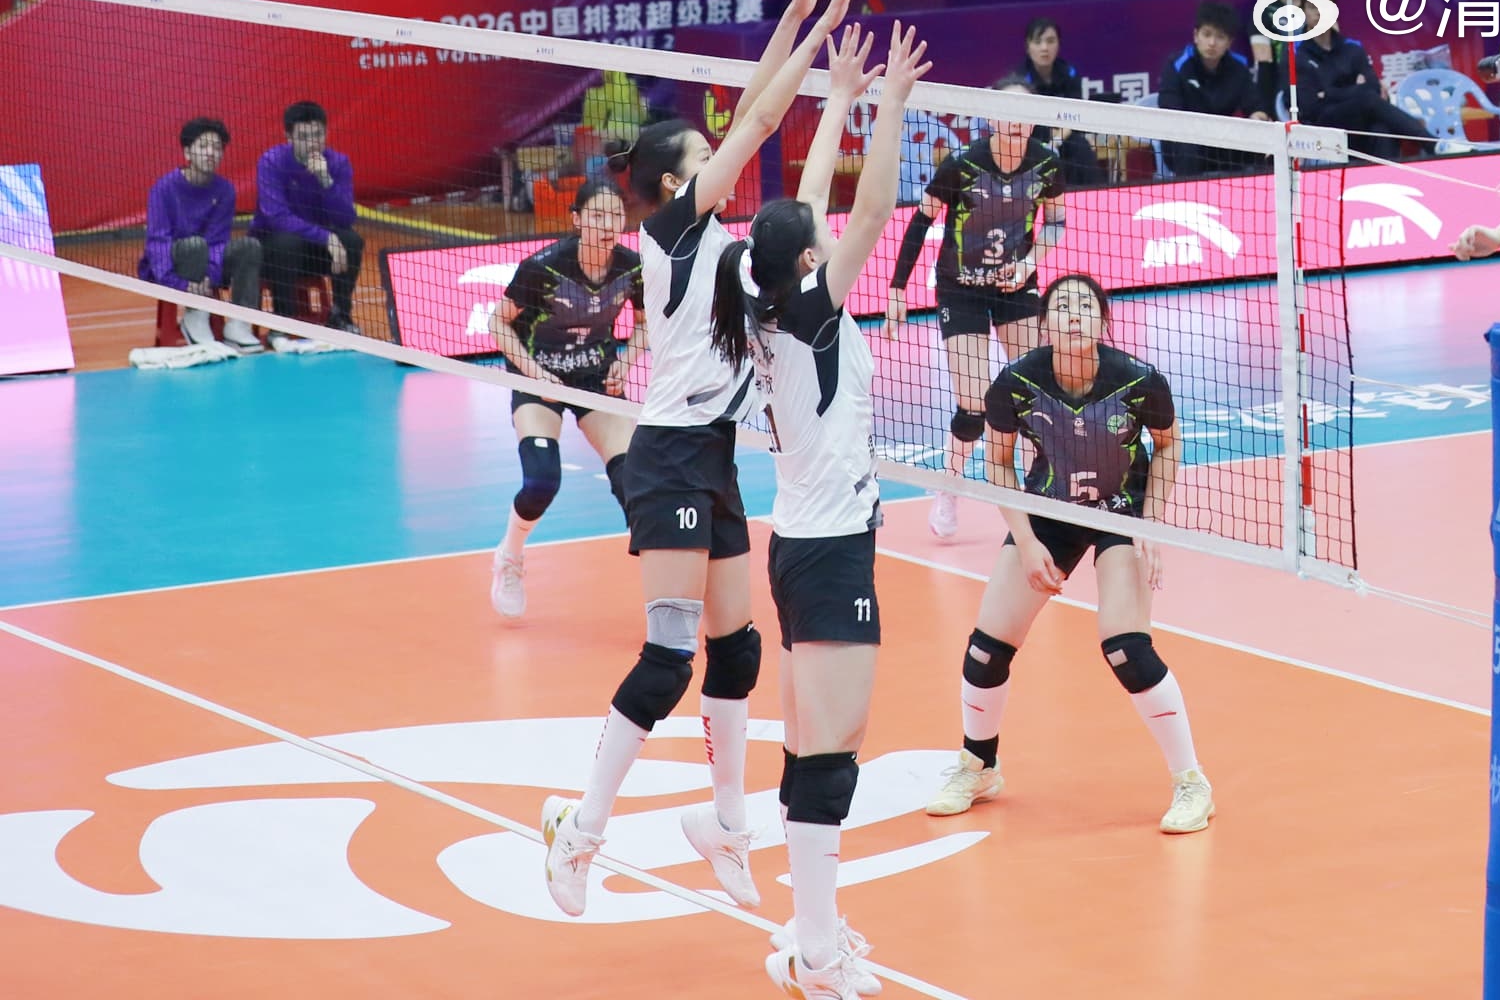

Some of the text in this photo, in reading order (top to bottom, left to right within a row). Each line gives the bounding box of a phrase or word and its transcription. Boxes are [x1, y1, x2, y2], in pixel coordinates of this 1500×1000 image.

[359, 51, 429, 69] CHINA
[1347, 214, 1406, 249] ANTA
[983, 229, 1006, 264] 3
[1142, 235, 1203, 269] ANTA
[941, 307, 950, 323] 3
[1070, 471, 1099, 504] 5
[676, 507, 698, 531] 10
[854, 598, 872, 622] 11
